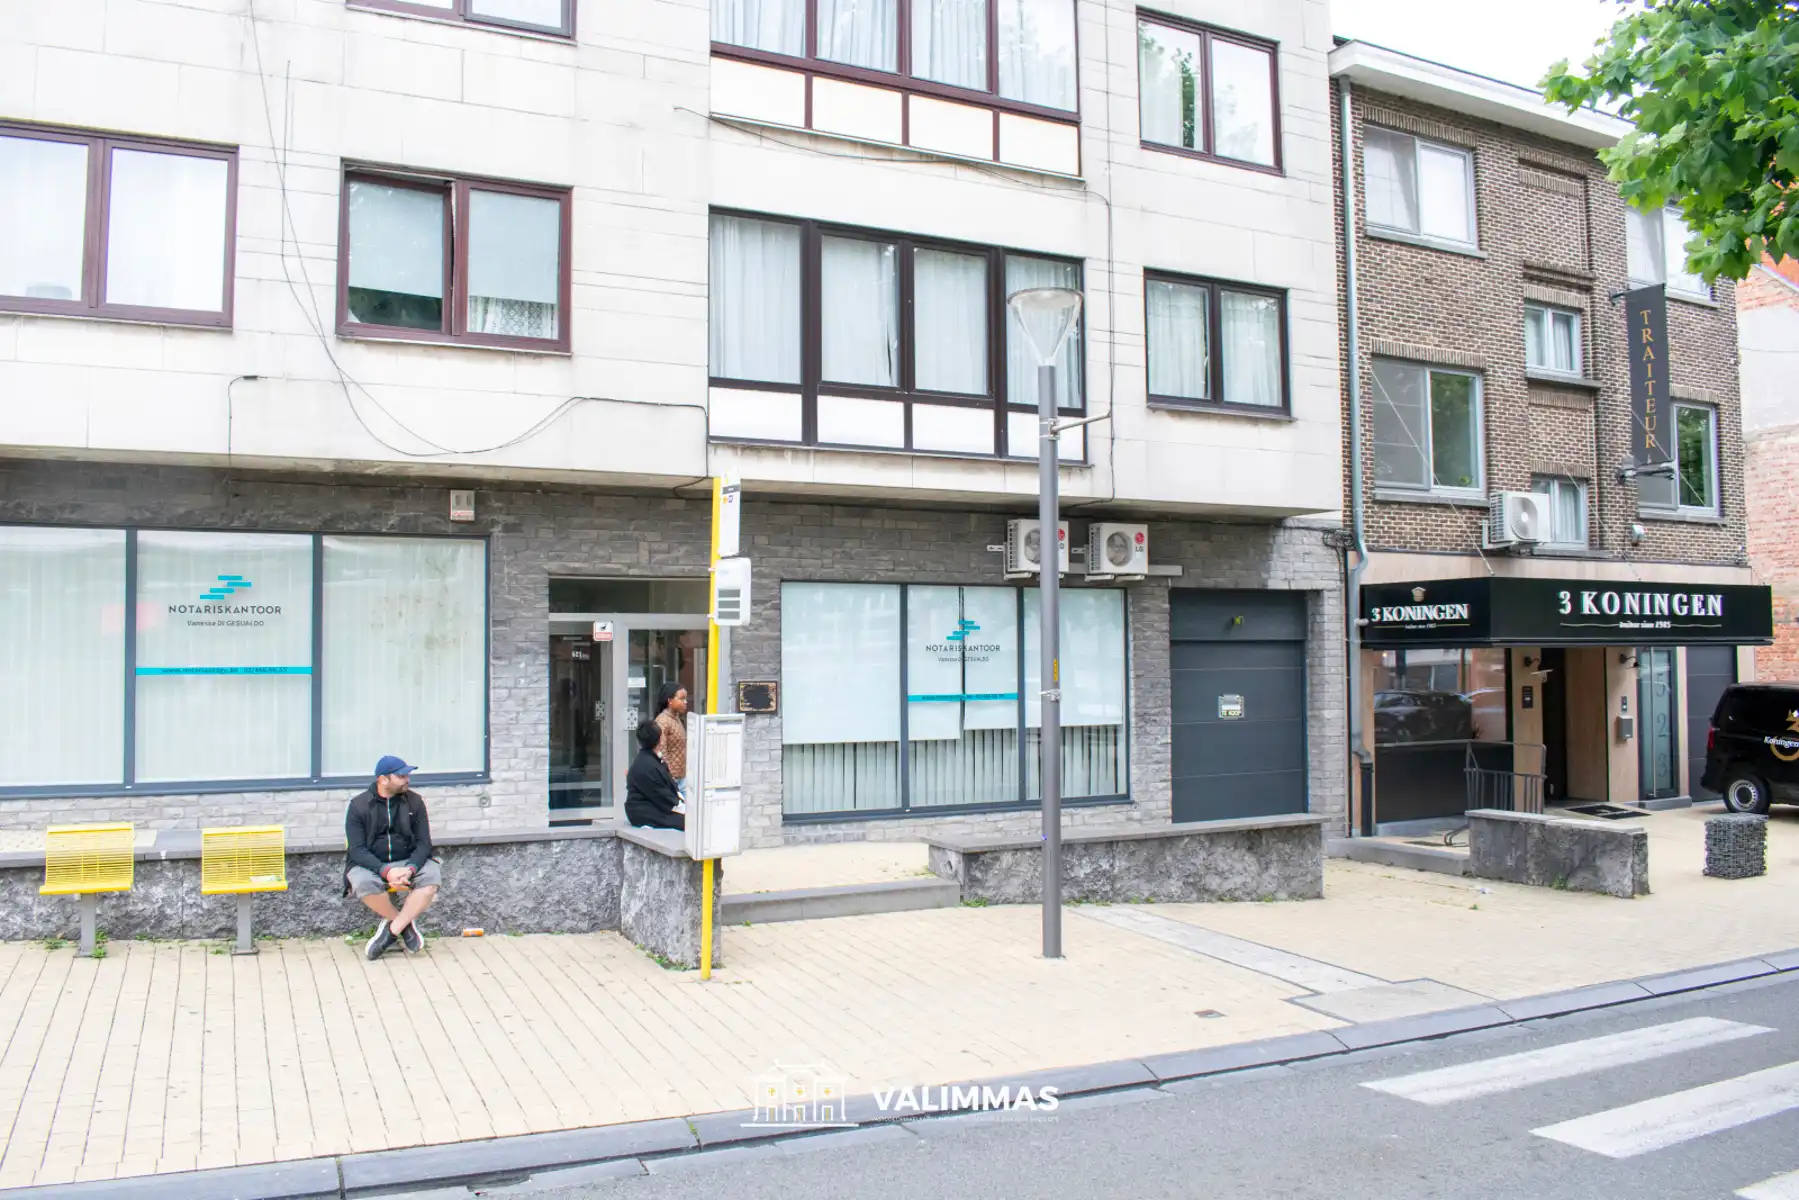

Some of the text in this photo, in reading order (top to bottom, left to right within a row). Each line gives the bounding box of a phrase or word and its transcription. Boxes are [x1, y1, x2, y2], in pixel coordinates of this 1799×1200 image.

[1640, 310, 1657, 449] TRAITEUR
[169, 605, 282, 614] NOTARISKANTOOR
[1559, 590, 1723, 616] 3 KONINGEN
[1371, 604, 1470, 622] 3 KONINGEN
[925, 644, 1000, 652] NOTARISKANTOOR
